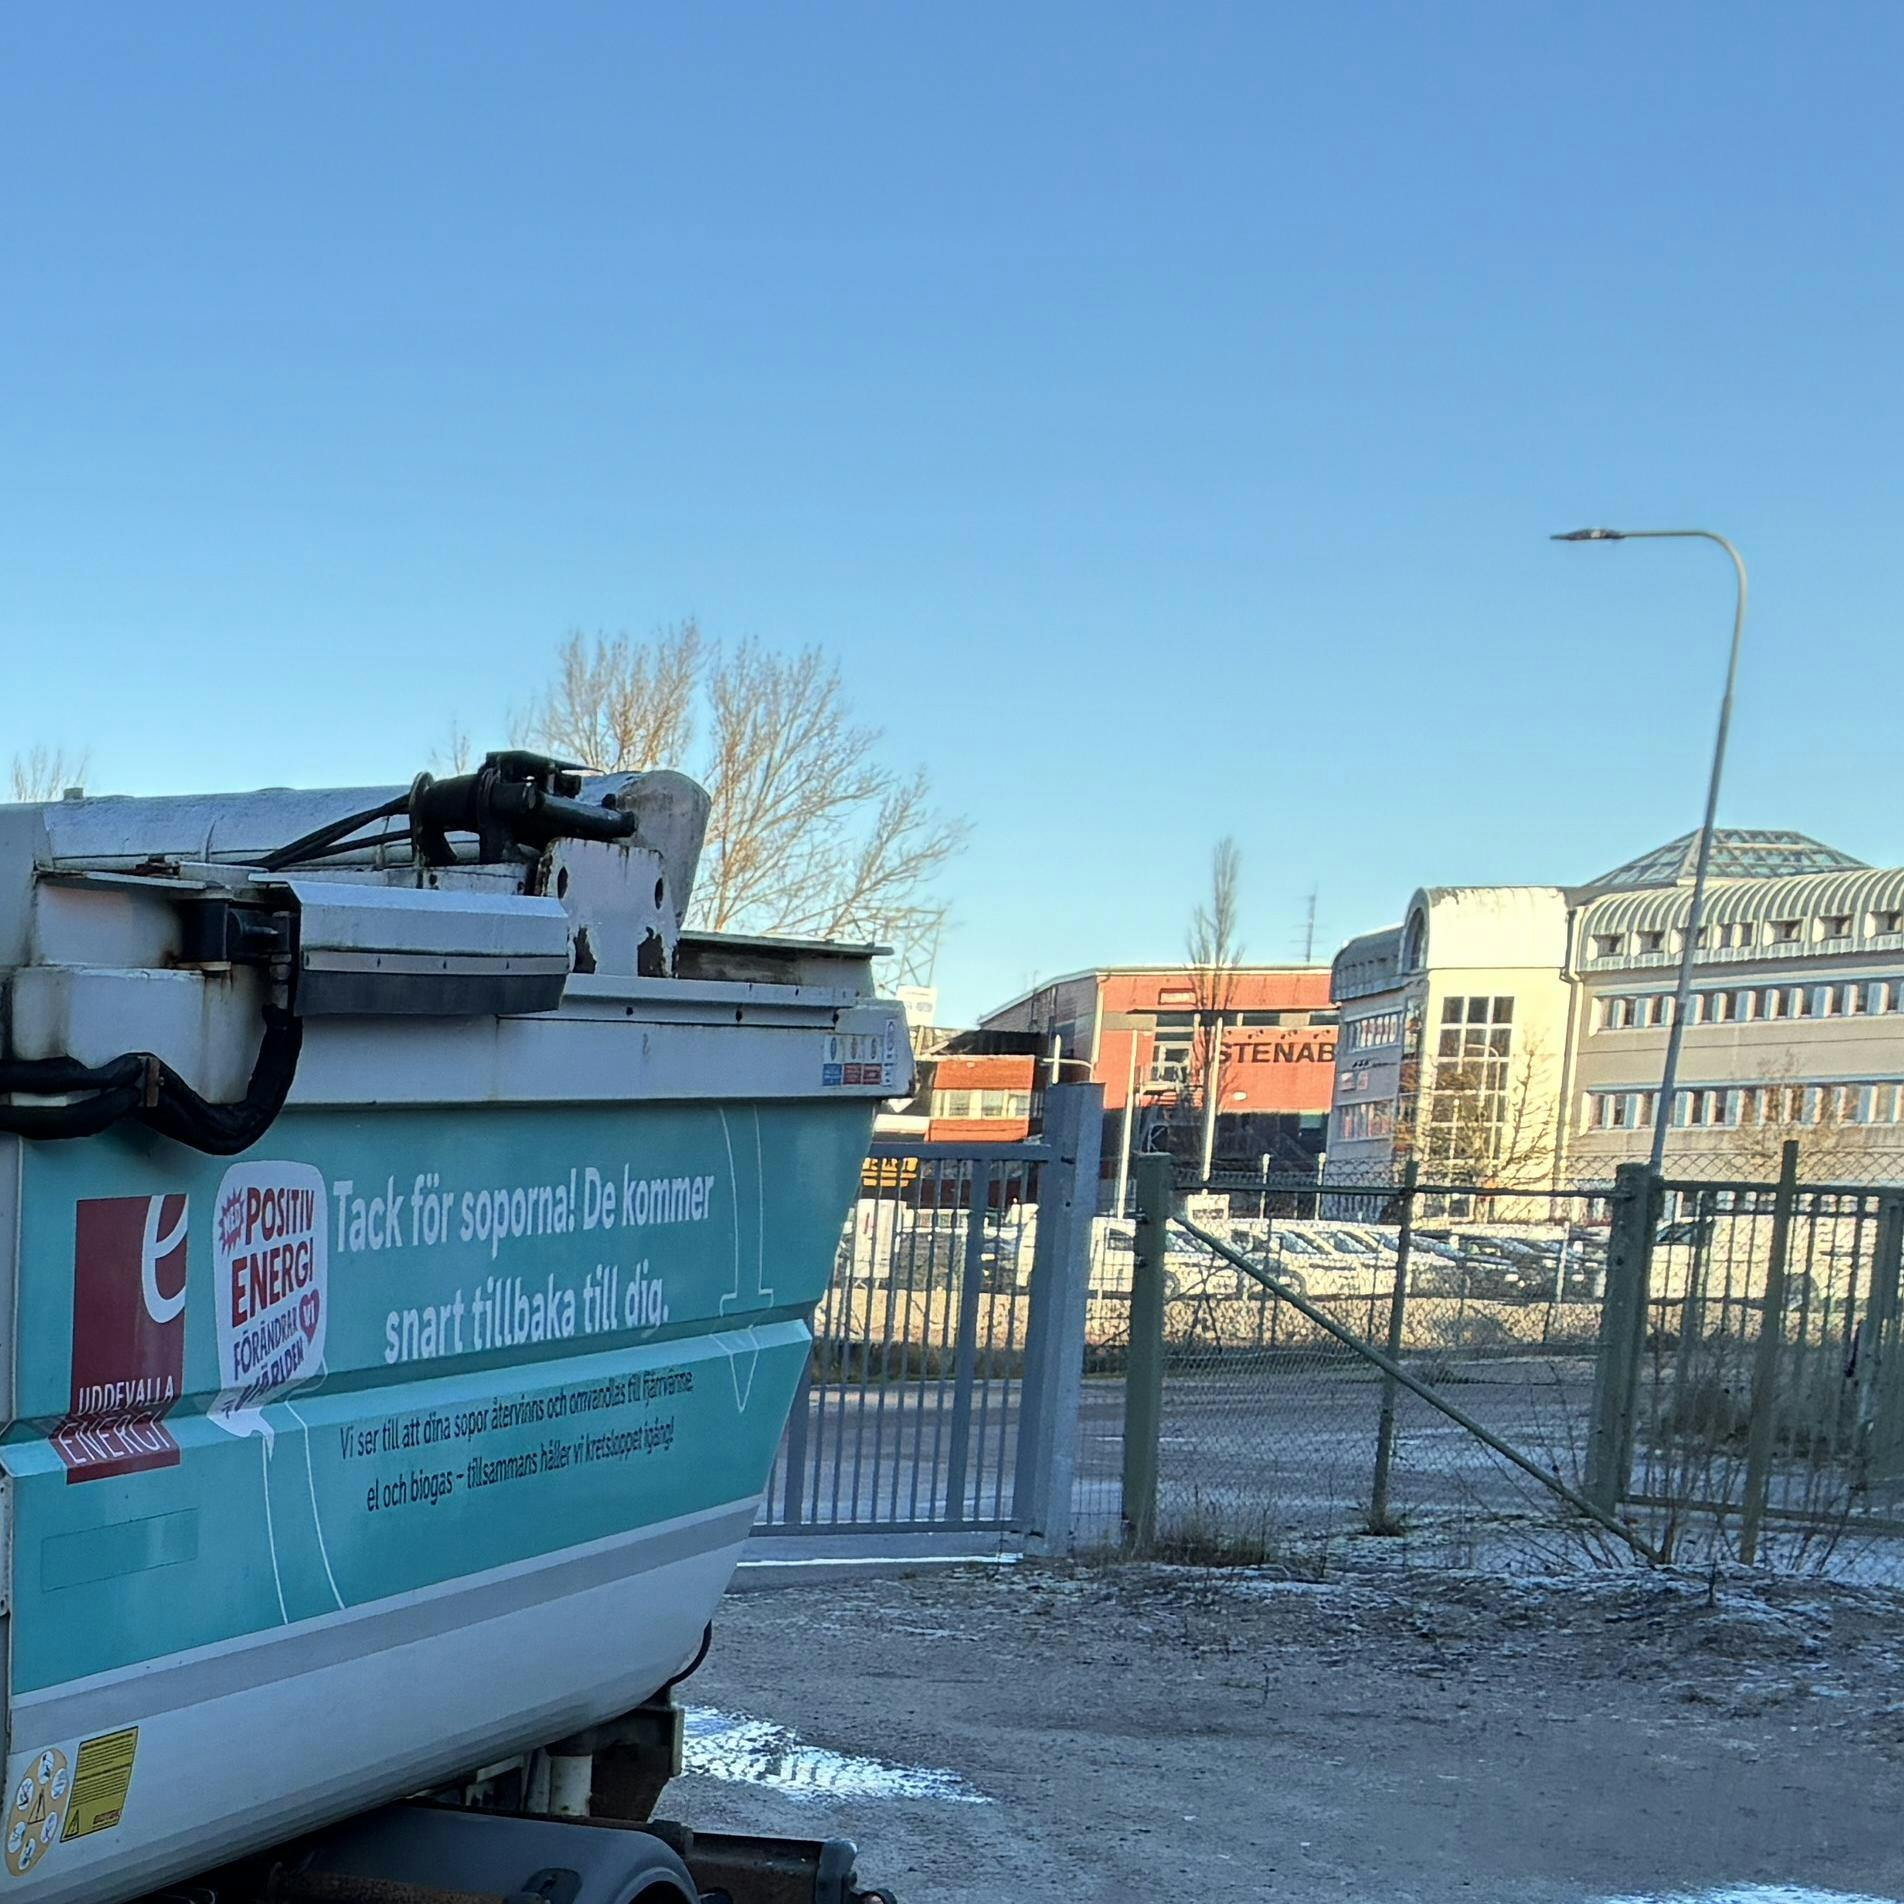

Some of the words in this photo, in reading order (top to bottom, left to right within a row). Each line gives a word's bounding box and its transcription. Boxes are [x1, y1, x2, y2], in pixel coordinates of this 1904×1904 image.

[245, 1187, 314, 1246] POSITIV
[333, 1175, 403, 1253] Tack
[411, 1173, 454, 1247] för
[460, 1167, 577, 1260] soporna!
[582, 1166, 616, 1231] De
[622, 1163, 715, 1227] kommer
[232, 1237, 313, 1328] ENERGI
[384, 1288, 464, 1364] snart
[472, 1272, 576, 1351] tillbaka
[584, 1263, 618, 1333] till
[625, 1259, 669, 1337] dig.
[233, 1306, 299, 1381] FÖRÄNDRAR
[235, 1336, 304, 1411] VÄRLDEN
[78, 1375, 175, 1416] UDDEVALLA
[340, 1426, 354, 1460] Vi
[358, 1428, 379, 1456] ser
[383, 1418, 400, 1451] till
[402, 1418, 421, 1447] att
[423, 1411, 451, 1443] dina
[454, 1409, 489, 1442] sopor
[491, 1394, 544, 1430] återvinns
[547, 1387, 567, 1419] och
[570, 1376, 625, 1414] omvandlas
[59, 1411, 172, 1464] ENERGI
[367, 1477, 379, 1512] el
[383, 1473, 407, 1508] och
[411, 1469, 452, 1506] biogas
[467, 1452, 537, 1489] tillsammans
[540, 1440, 571, 1473] håller
[574, 1434, 585, 1465] vi
